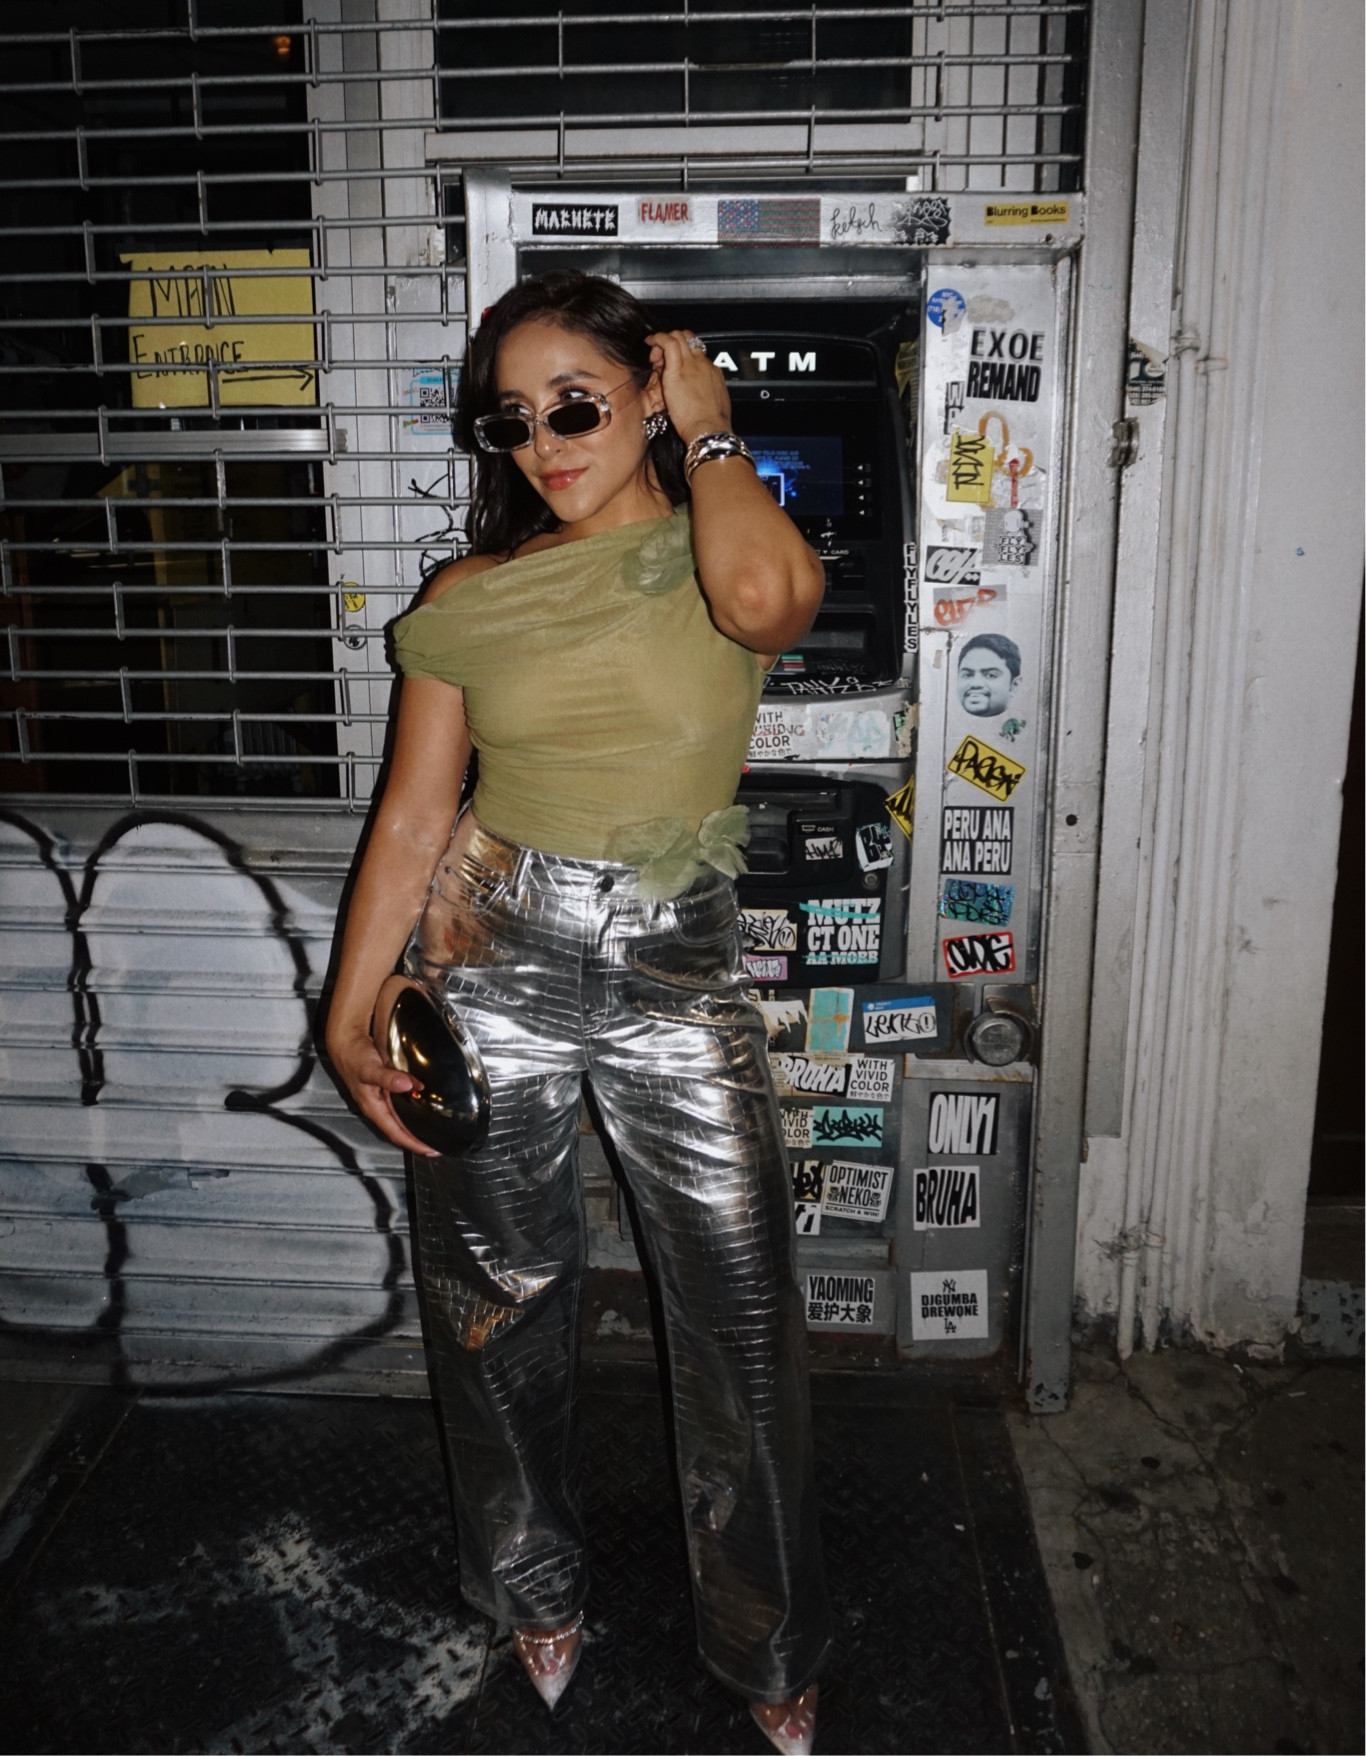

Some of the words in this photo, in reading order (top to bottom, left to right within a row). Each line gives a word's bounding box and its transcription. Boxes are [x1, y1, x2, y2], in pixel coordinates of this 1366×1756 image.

[535, 208, 615, 232] MACHETE
[641, 203, 689, 223] FLAMER
[986, 206, 1029, 218] Blurring
[1030, 204, 1067, 216] Books
[148, 264, 235, 317] MAIN
[970, 328, 1045, 363] EXOE
[713, 352, 817, 372] ATM
[966, 361, 1042, 402] REMAND
[1000, 554, 1021, 563] LES
[943, 810, 979, 840] PERU
[982, 811, 1011, 841] ANA
[942, 841, 971, 871] ANA
[974, 842, 1011, 873] PERU
[807, 926, 835, 951] CT
[838, 925, 880, 951] ONE
[857, 1059, 888, 1071] WITH
[850, 1080, 890, 1092] COLOR
[855, 1070, 888, 1082] VIVID
[781, 1128, 810, 1139] OLOR
[929, 1094, 996, 1154] ONLY1
[829, 1165, 888, 1191] OPTIMIST
[838, 1185, 871, 1207] NEKO
[916, 1169, 976, 1225] BRUHA
[825, 1205, 856, 1214] SCRATCH
[809, 1276, 873, 1303] YAOMING
[921, 1293, 978, 1306] DJGUMBA
[808, 1302, 872, 1323] 爱护大象
[921, 1305, 979, 1319] DREWONE
